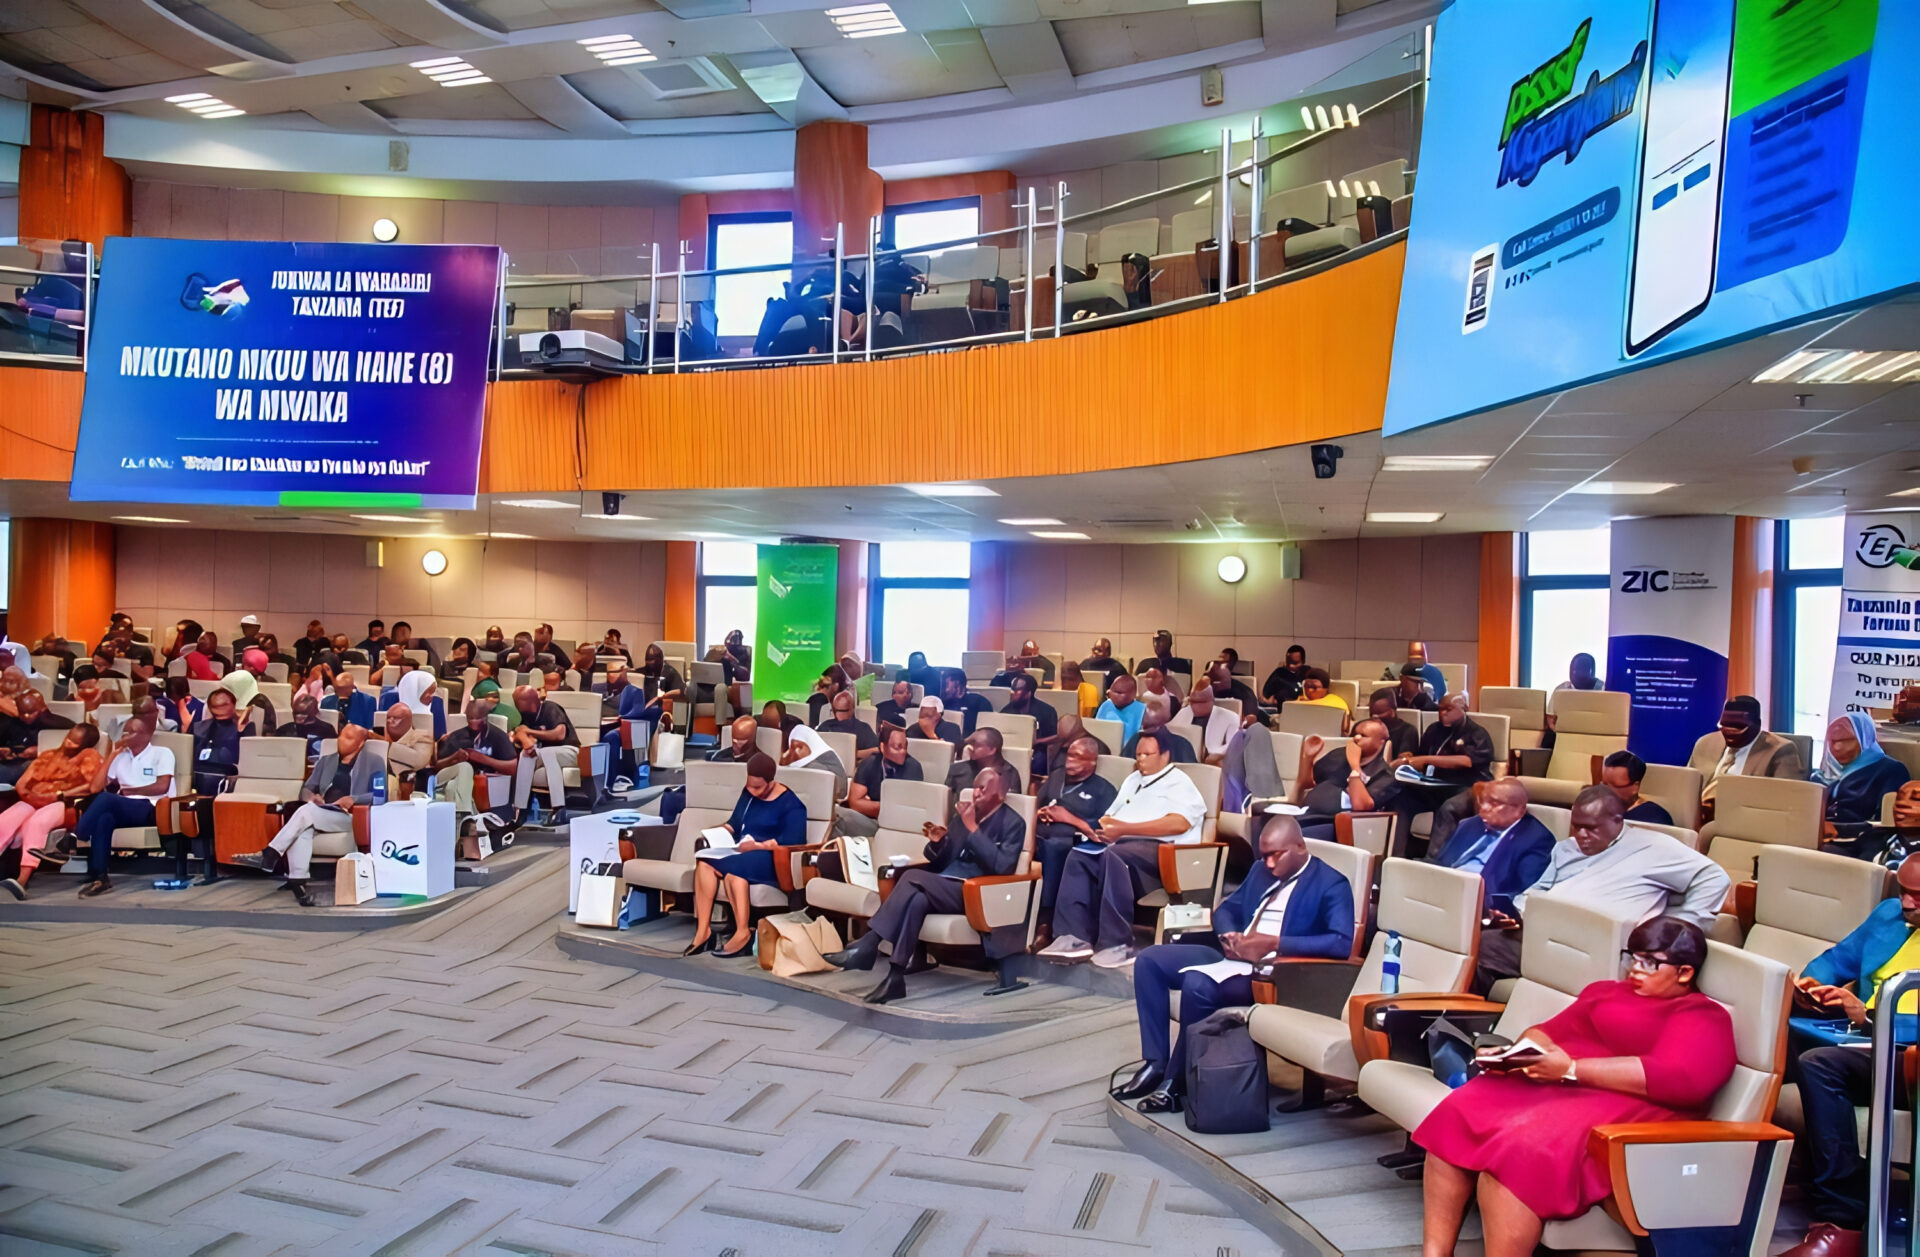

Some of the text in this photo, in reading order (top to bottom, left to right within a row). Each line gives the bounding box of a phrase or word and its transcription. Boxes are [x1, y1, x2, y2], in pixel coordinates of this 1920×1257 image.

[120, 346, 454, 385] MKUTANO MKUU WA NANE (8)
[215, 388, 348, 423] WA MWAKA
[1621, 570, 1669, 593] ZIC
[1850, 652, 1882, 665] OUR
